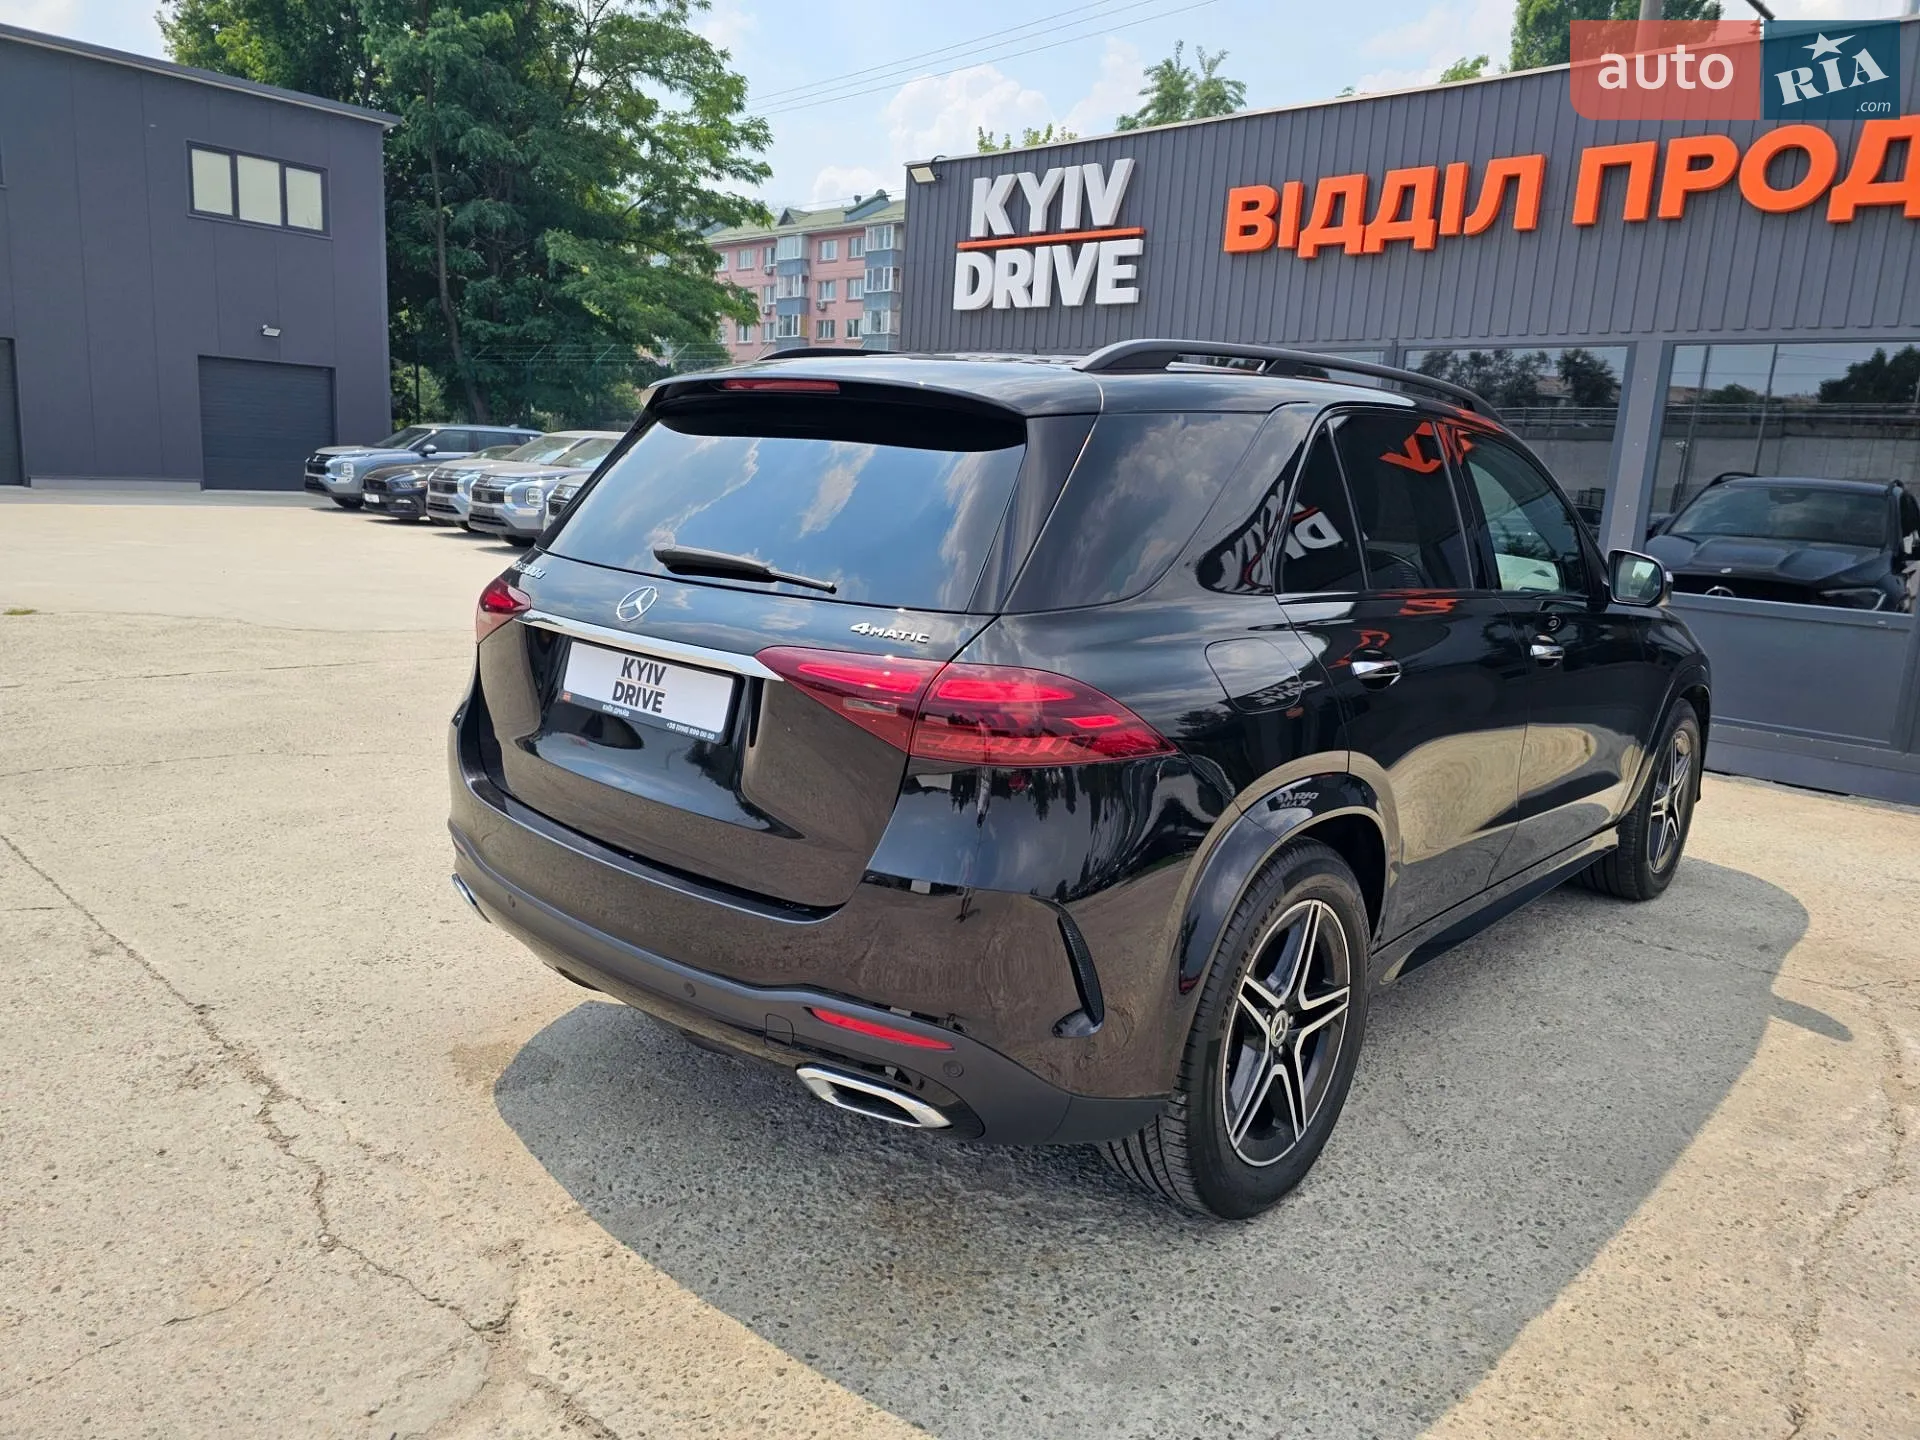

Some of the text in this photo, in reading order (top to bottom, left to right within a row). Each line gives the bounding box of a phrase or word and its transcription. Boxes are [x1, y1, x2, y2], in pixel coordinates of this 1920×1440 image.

[970, 158, 1135, 237] KYIV
[1223, 114, 1920, 258] ВІДДІЛ ПРОД
[953, 238, 1143, 310] DRIVE
[850, 622, 930, 644] 4MATIC
[612, 680, 666, 713] DRIVE
[621, 656, 667, 686] KYIV
